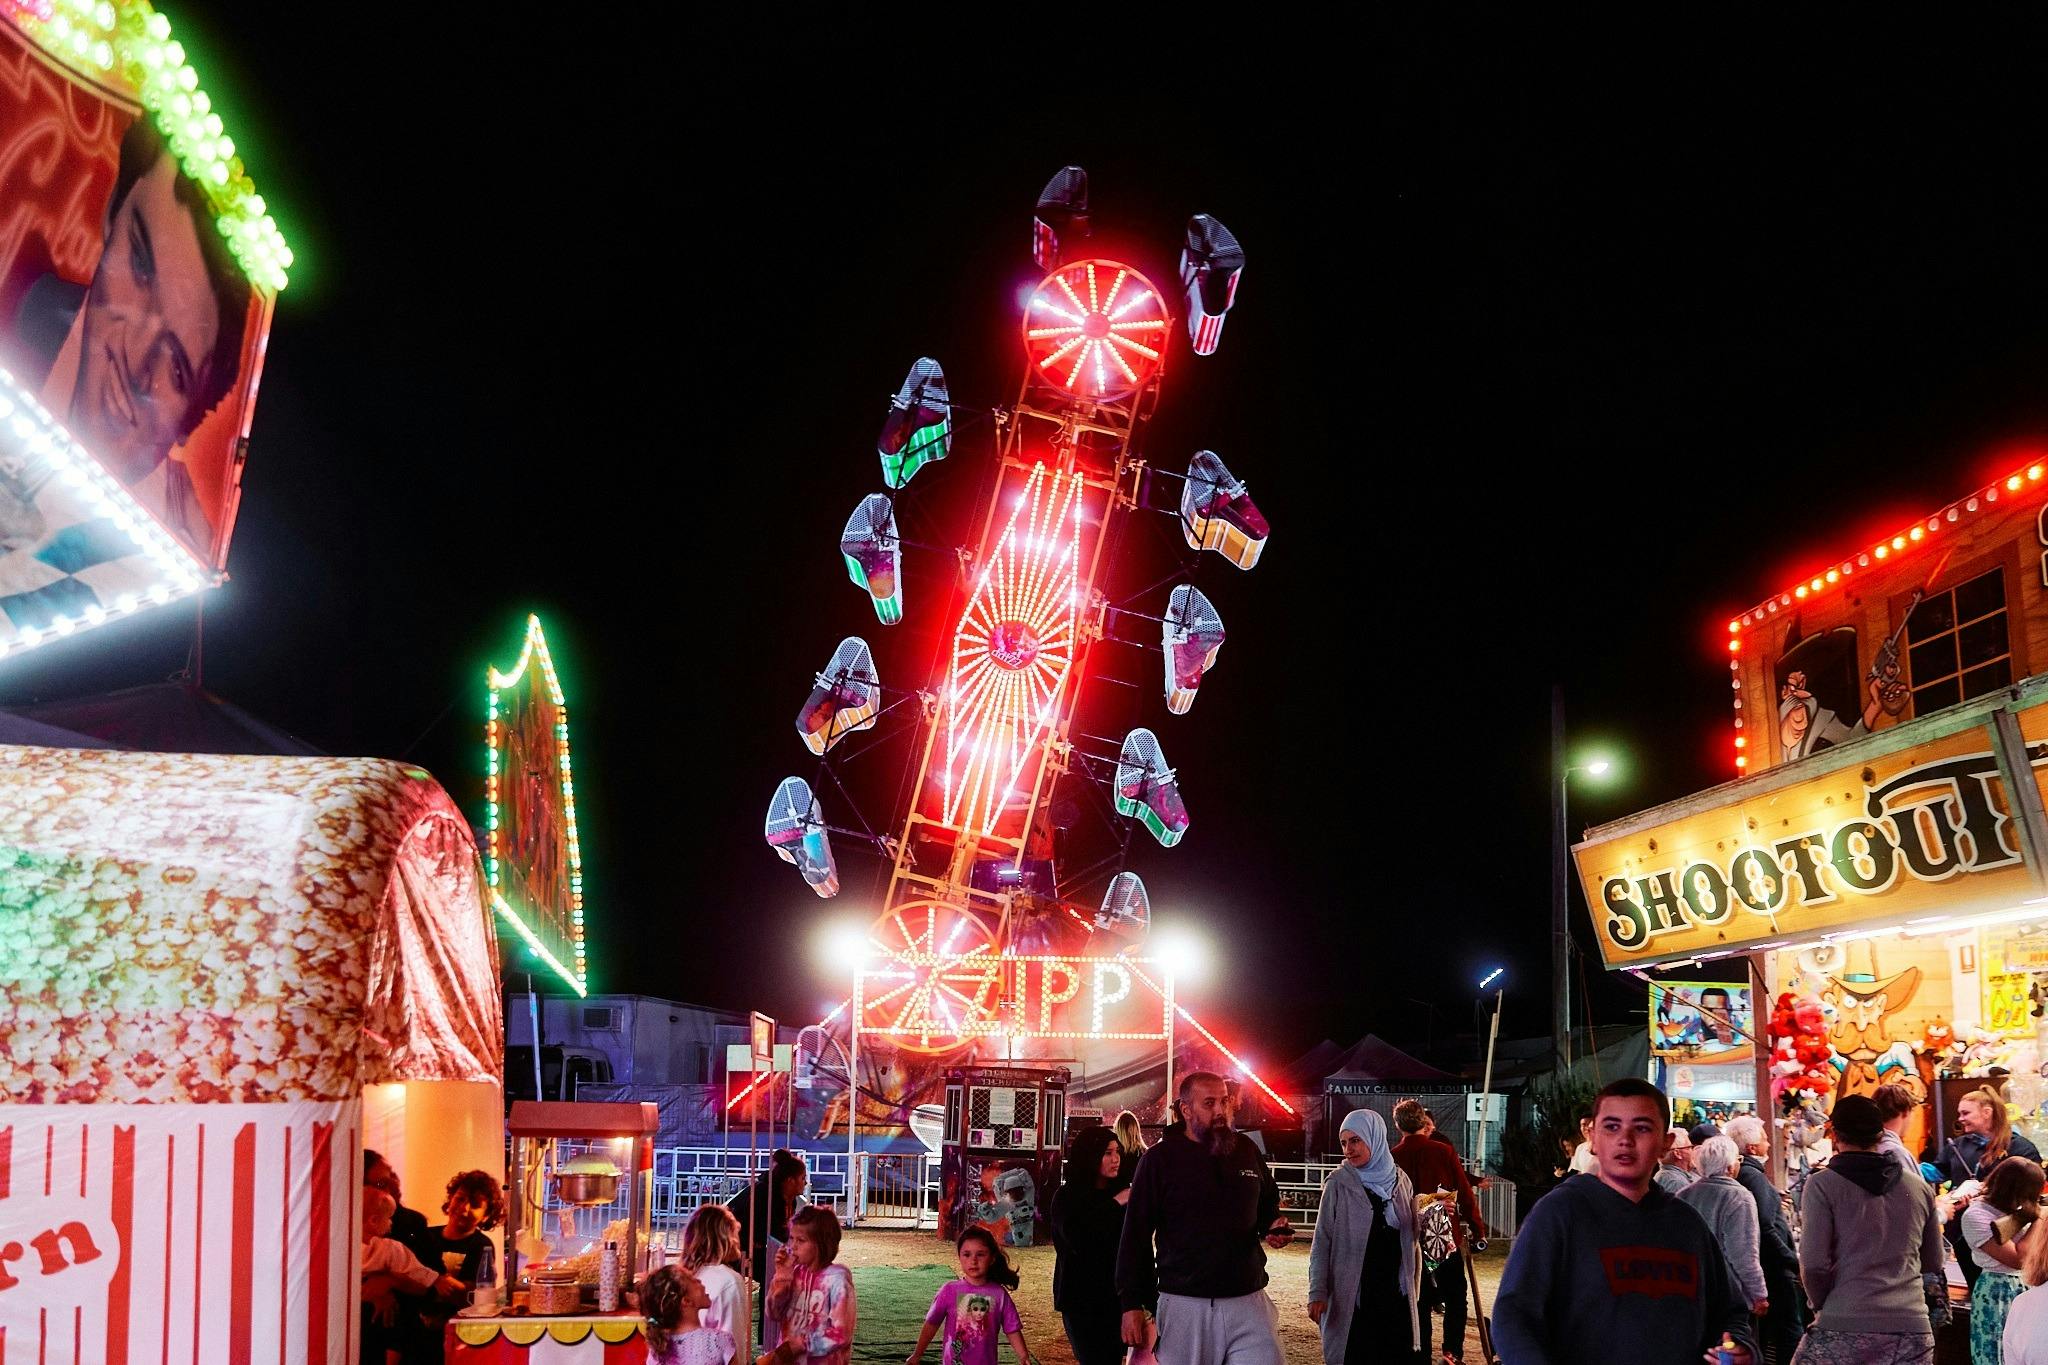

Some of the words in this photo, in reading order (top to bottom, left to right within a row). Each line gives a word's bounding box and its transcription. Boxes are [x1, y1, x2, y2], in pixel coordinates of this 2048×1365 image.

[1602, 738, 2048, 951] SHOOTOUT
[1328, 1083, 1370, 1094] FAMILY
[1373, 1084, 1432, 1094] CARNIVAL
[1069, 1109, 1102, 1117] ATTENTION
